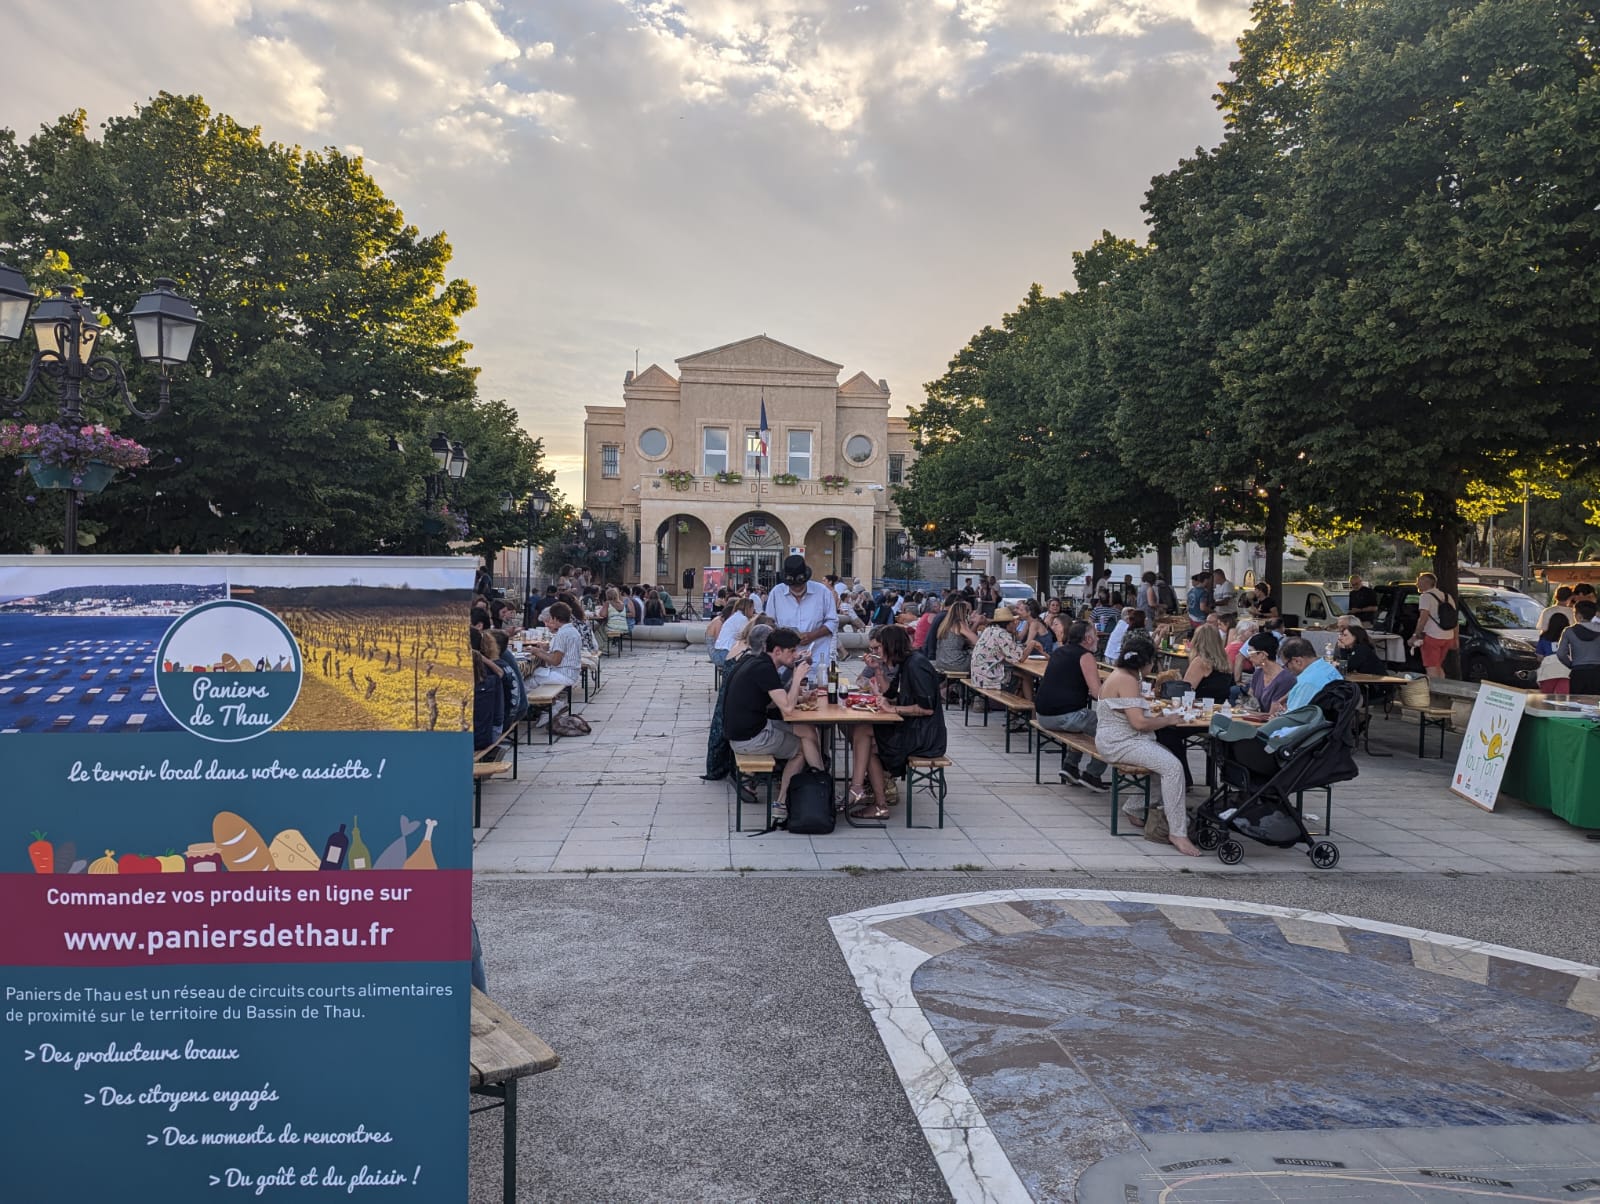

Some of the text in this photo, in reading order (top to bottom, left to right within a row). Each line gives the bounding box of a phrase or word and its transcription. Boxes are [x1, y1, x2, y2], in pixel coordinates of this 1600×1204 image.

[750, 484, 769, 494] DE
[799, 484, 845, 496] VILLE
[192, 676, 270, 702] Paniers
[189, 703, 272, 728] de Thau
[67, 760, 91, 783] Le
[91, 761, 157, 782] terroir
[159, 758, 203, 781] local
[204, 758, 249, 781] dans
[251, 759, 300, 780] votre
[301, 759, 373, 780] assiette
[46, 884, 413, 907] Commandez vos produits en ligne sur
[63, 921, 395, 956] www.paniersdethau.fr
[6, 982, 453, 1002] Paniers de Thau est un réseau de circuits courts alimentaires
[5, 1004, 366, 1026] de proximité sur le territoire du Bassin de Thau.
[38, 1042, 74, 1063] Des
[73, 1041, 182, 1071] producteurs
[184, 1038, 240, 1060] locaux
[98, 1086, 136, 1107] Des
[138, 1083, 211, 1113] citoyens
[212, 1081, 280, 1112] engagés
[162, 1126, 199, 1147] Des
[201, 1123, 276, 1145] moments
[278, 1122, 301, 1144] de
[303, 1123, 393, 1144] rencontres
[224, 1167, 254, 1188] Du
[254, 1166, 297, 1196] goût
[299, 1166, 319, 1187] et
[321, 1165, 347, 1187] du
[347, 1164, 408, 1194] plaisir
